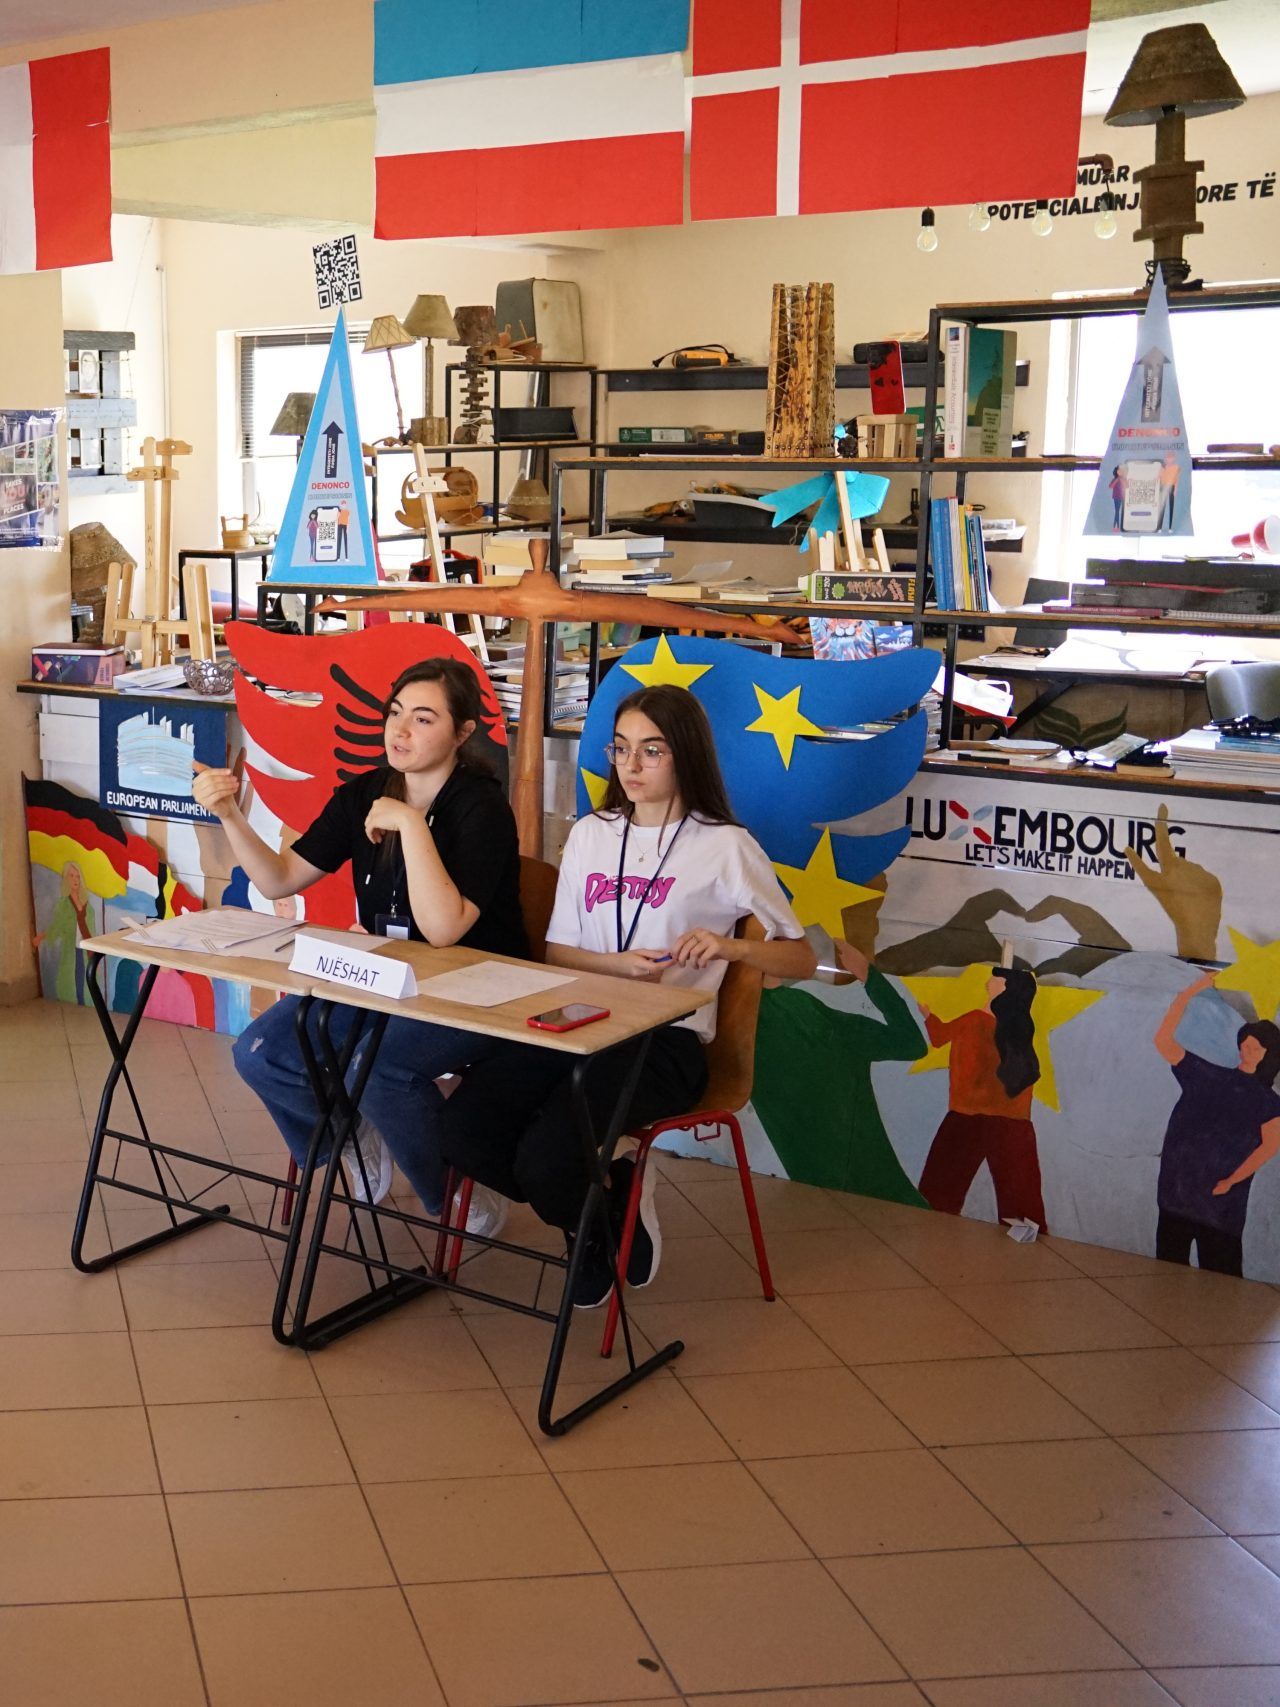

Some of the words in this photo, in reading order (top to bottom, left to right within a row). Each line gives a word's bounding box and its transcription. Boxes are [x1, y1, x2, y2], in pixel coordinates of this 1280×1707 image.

[988, 193, 1105, 221] POTECIALE
[1246, 172, 1277, 198] TË
[311, 481, 350, 490] DENONCO
[106, 791, 158, 810] EUROPEAN
[965, 843, 1010, 864] LET'S
[1014, 849, 1055, 871] MAKE
[1058, 853, 1073, 873] IT
[1077, 856, 1136, 881] HAPPEN
[316, 955, 380, 987] NJËSHAT
